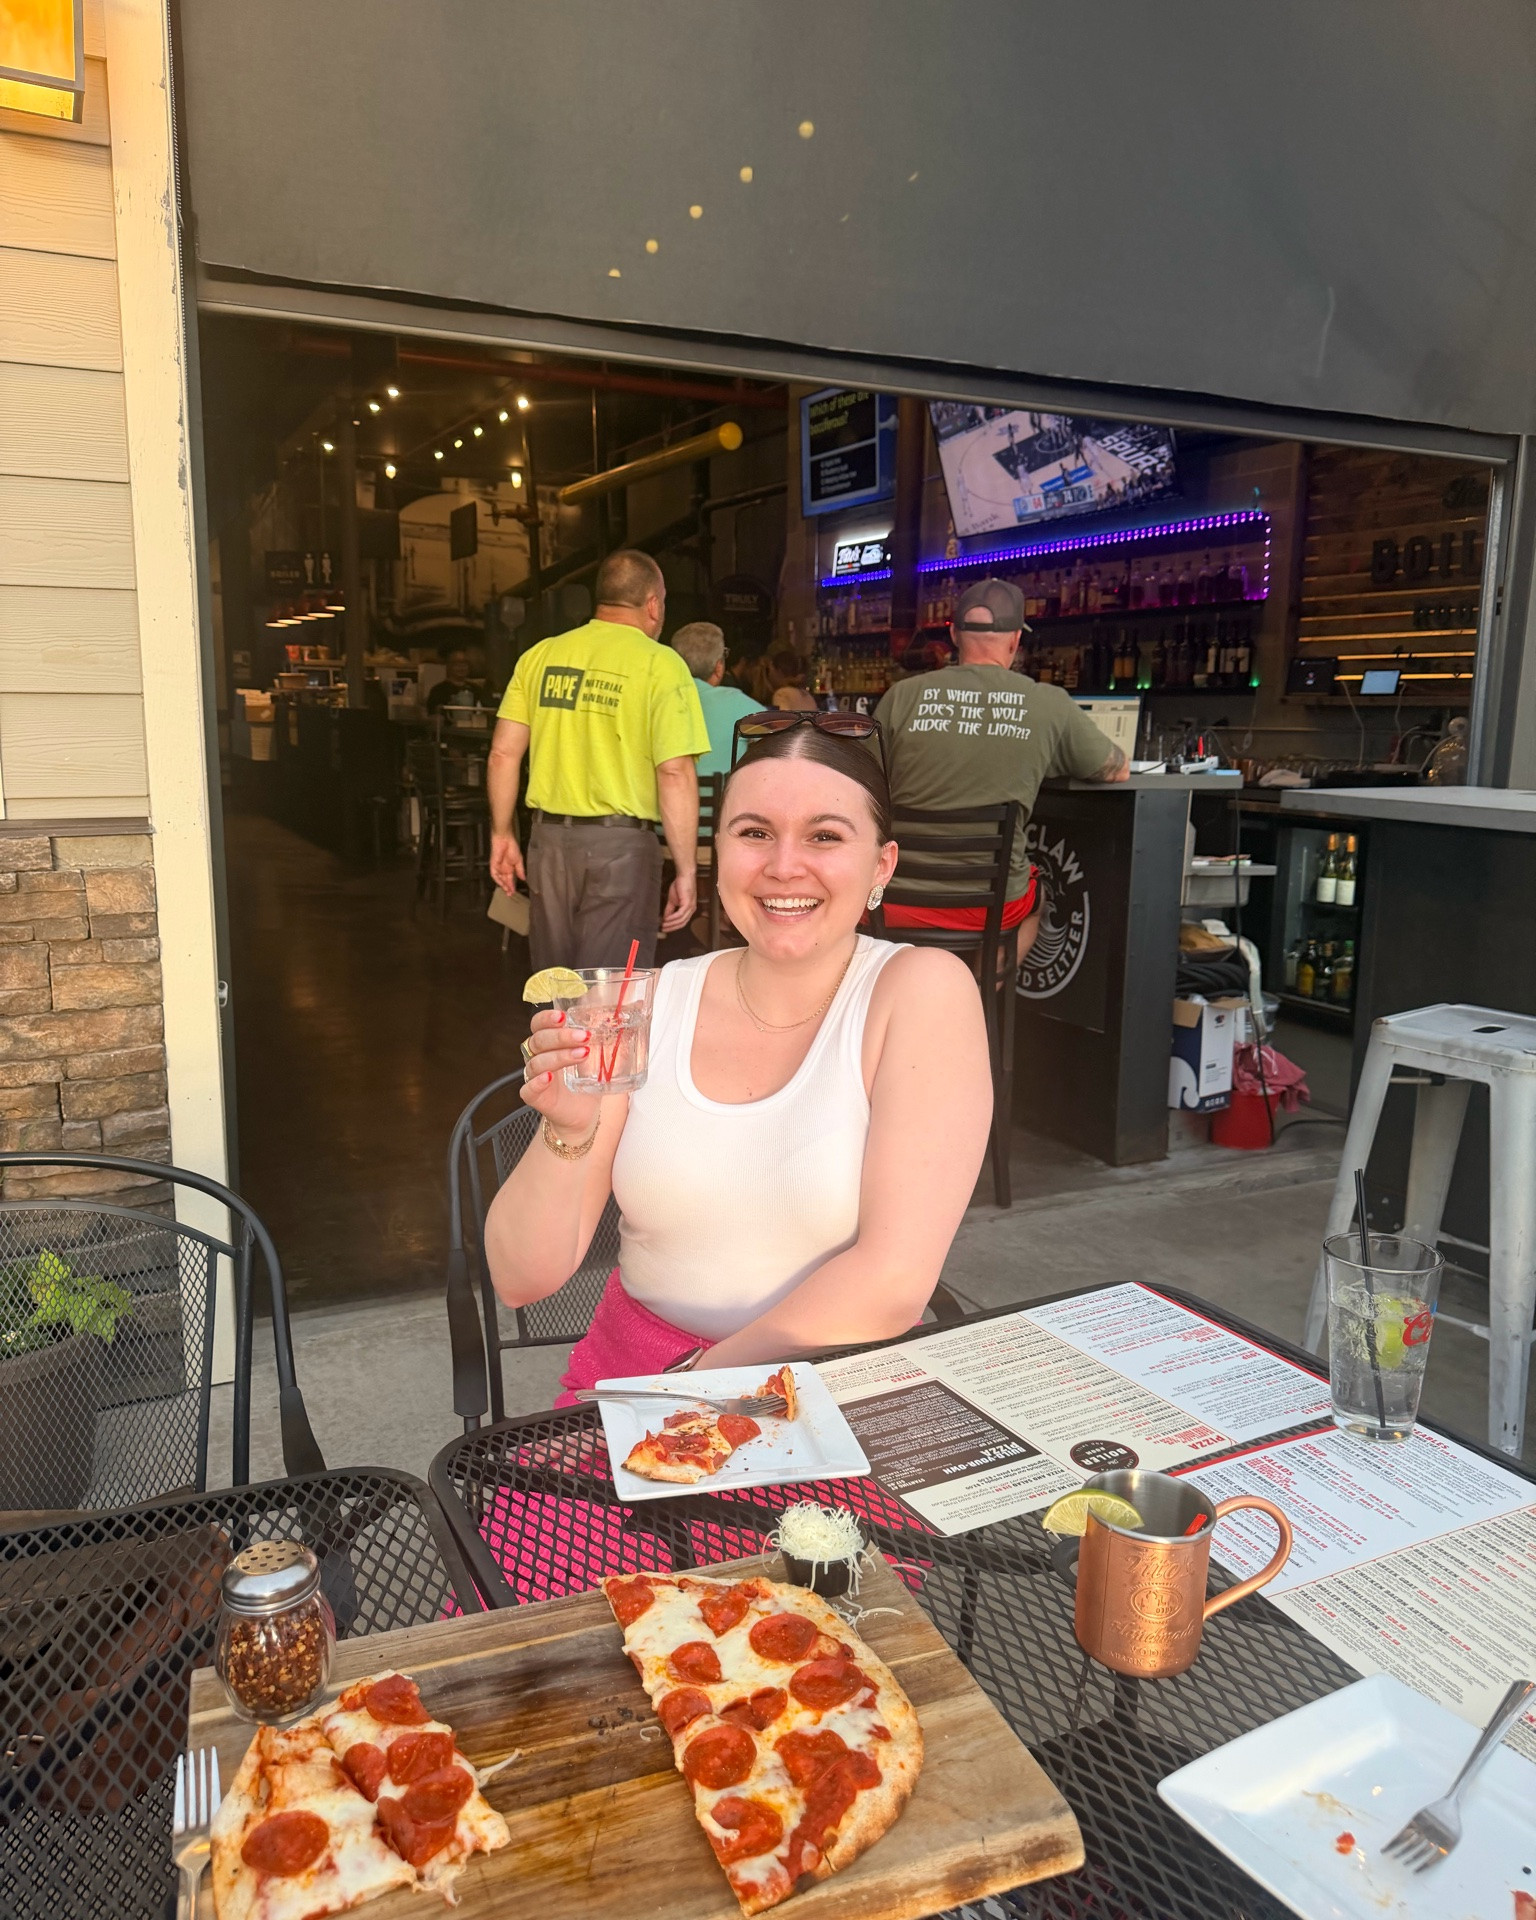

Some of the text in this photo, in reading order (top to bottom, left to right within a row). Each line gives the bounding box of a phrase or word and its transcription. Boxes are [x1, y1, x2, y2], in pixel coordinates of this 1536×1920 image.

[923, 688, 1025, 705] BY WHAT RIGHT
[918, 704, 1028, 721] DOES THE WOLF
[909, 719, 1031, 740] JUDGE THE LION?!?
[1024, 823, 1084, 885] CLAW
[1038, 910, 1084, 988] SELTZER
[981, 1443, 1021, 1456] PIZZA
[1084, 1446, 1105, 1455] ROOM
[1188, 1434, 1224, 1449] PIZZA
[1303, 1442, 1327, 1456] SOUP
[942, 1446, 1025, 1473] BUILD-YOUR-OWN
[1081, 1447, 1126, 1465] BOILER
[1260, 1455, 1294, 1476] SALADS
[1361, 1457, 1382, 1469] BACON
[1196, 1475, 1214, 1488] GREEK
[1212, 1487, 1227, 1496] (GF)
[1212, 1470, 1235, 1485] CLASSIC
[1280, 1449, 1297, 1459] SOUP
[1295, 1459, 1309, 1467] AND
[1308, 1466, 1328, 1479] SALAD
[1358, 1497, 1374, 1508] BOWL
[1291, 1446, 1307, 1456] SOUP
[1314, 1460, 1327, 1468] THE
[1326, 1467, 1340, 1476] DAY
[1367, 1493, 1383, 1503] BOWL
[1236, 1462, 1257, 1476] BOILER
[1256, 1475, 1276, 1488] HOUSE
[1287, 1495, 1300, 1505] SIDE
[1318, 1516, 1343, 1533] REGULAR
[1219, 1521, 1243, 1539] REGULAR
[1480, 1525, 1525, 1554] MARGHERITA
[1448, 1535, 1496, 1565] CASA BLANCA
[1465, 1530, 1505, 1555] THE WORKS
[1397, 1554, 1429, 1576] FIREBALL
[1412, 1548, 1459, 1578] BBQ CHICKEN
[1429, 1542, 1469, 1568] CARNIVORE
[1375, 1561, 1418, 1589] GREEK GOAT
[1298, 1589, 1316, 1602] TACO
[1315, 1583, 1341, 1601] BOILER
[1340, 1601, 1379, 1630] REDUCTION
[1333, 1577, 1385, 1615] CRIMINILICIOUS
[1354, 1569, 1449, 1635] CHICKEN BACON ARTICHOKE
